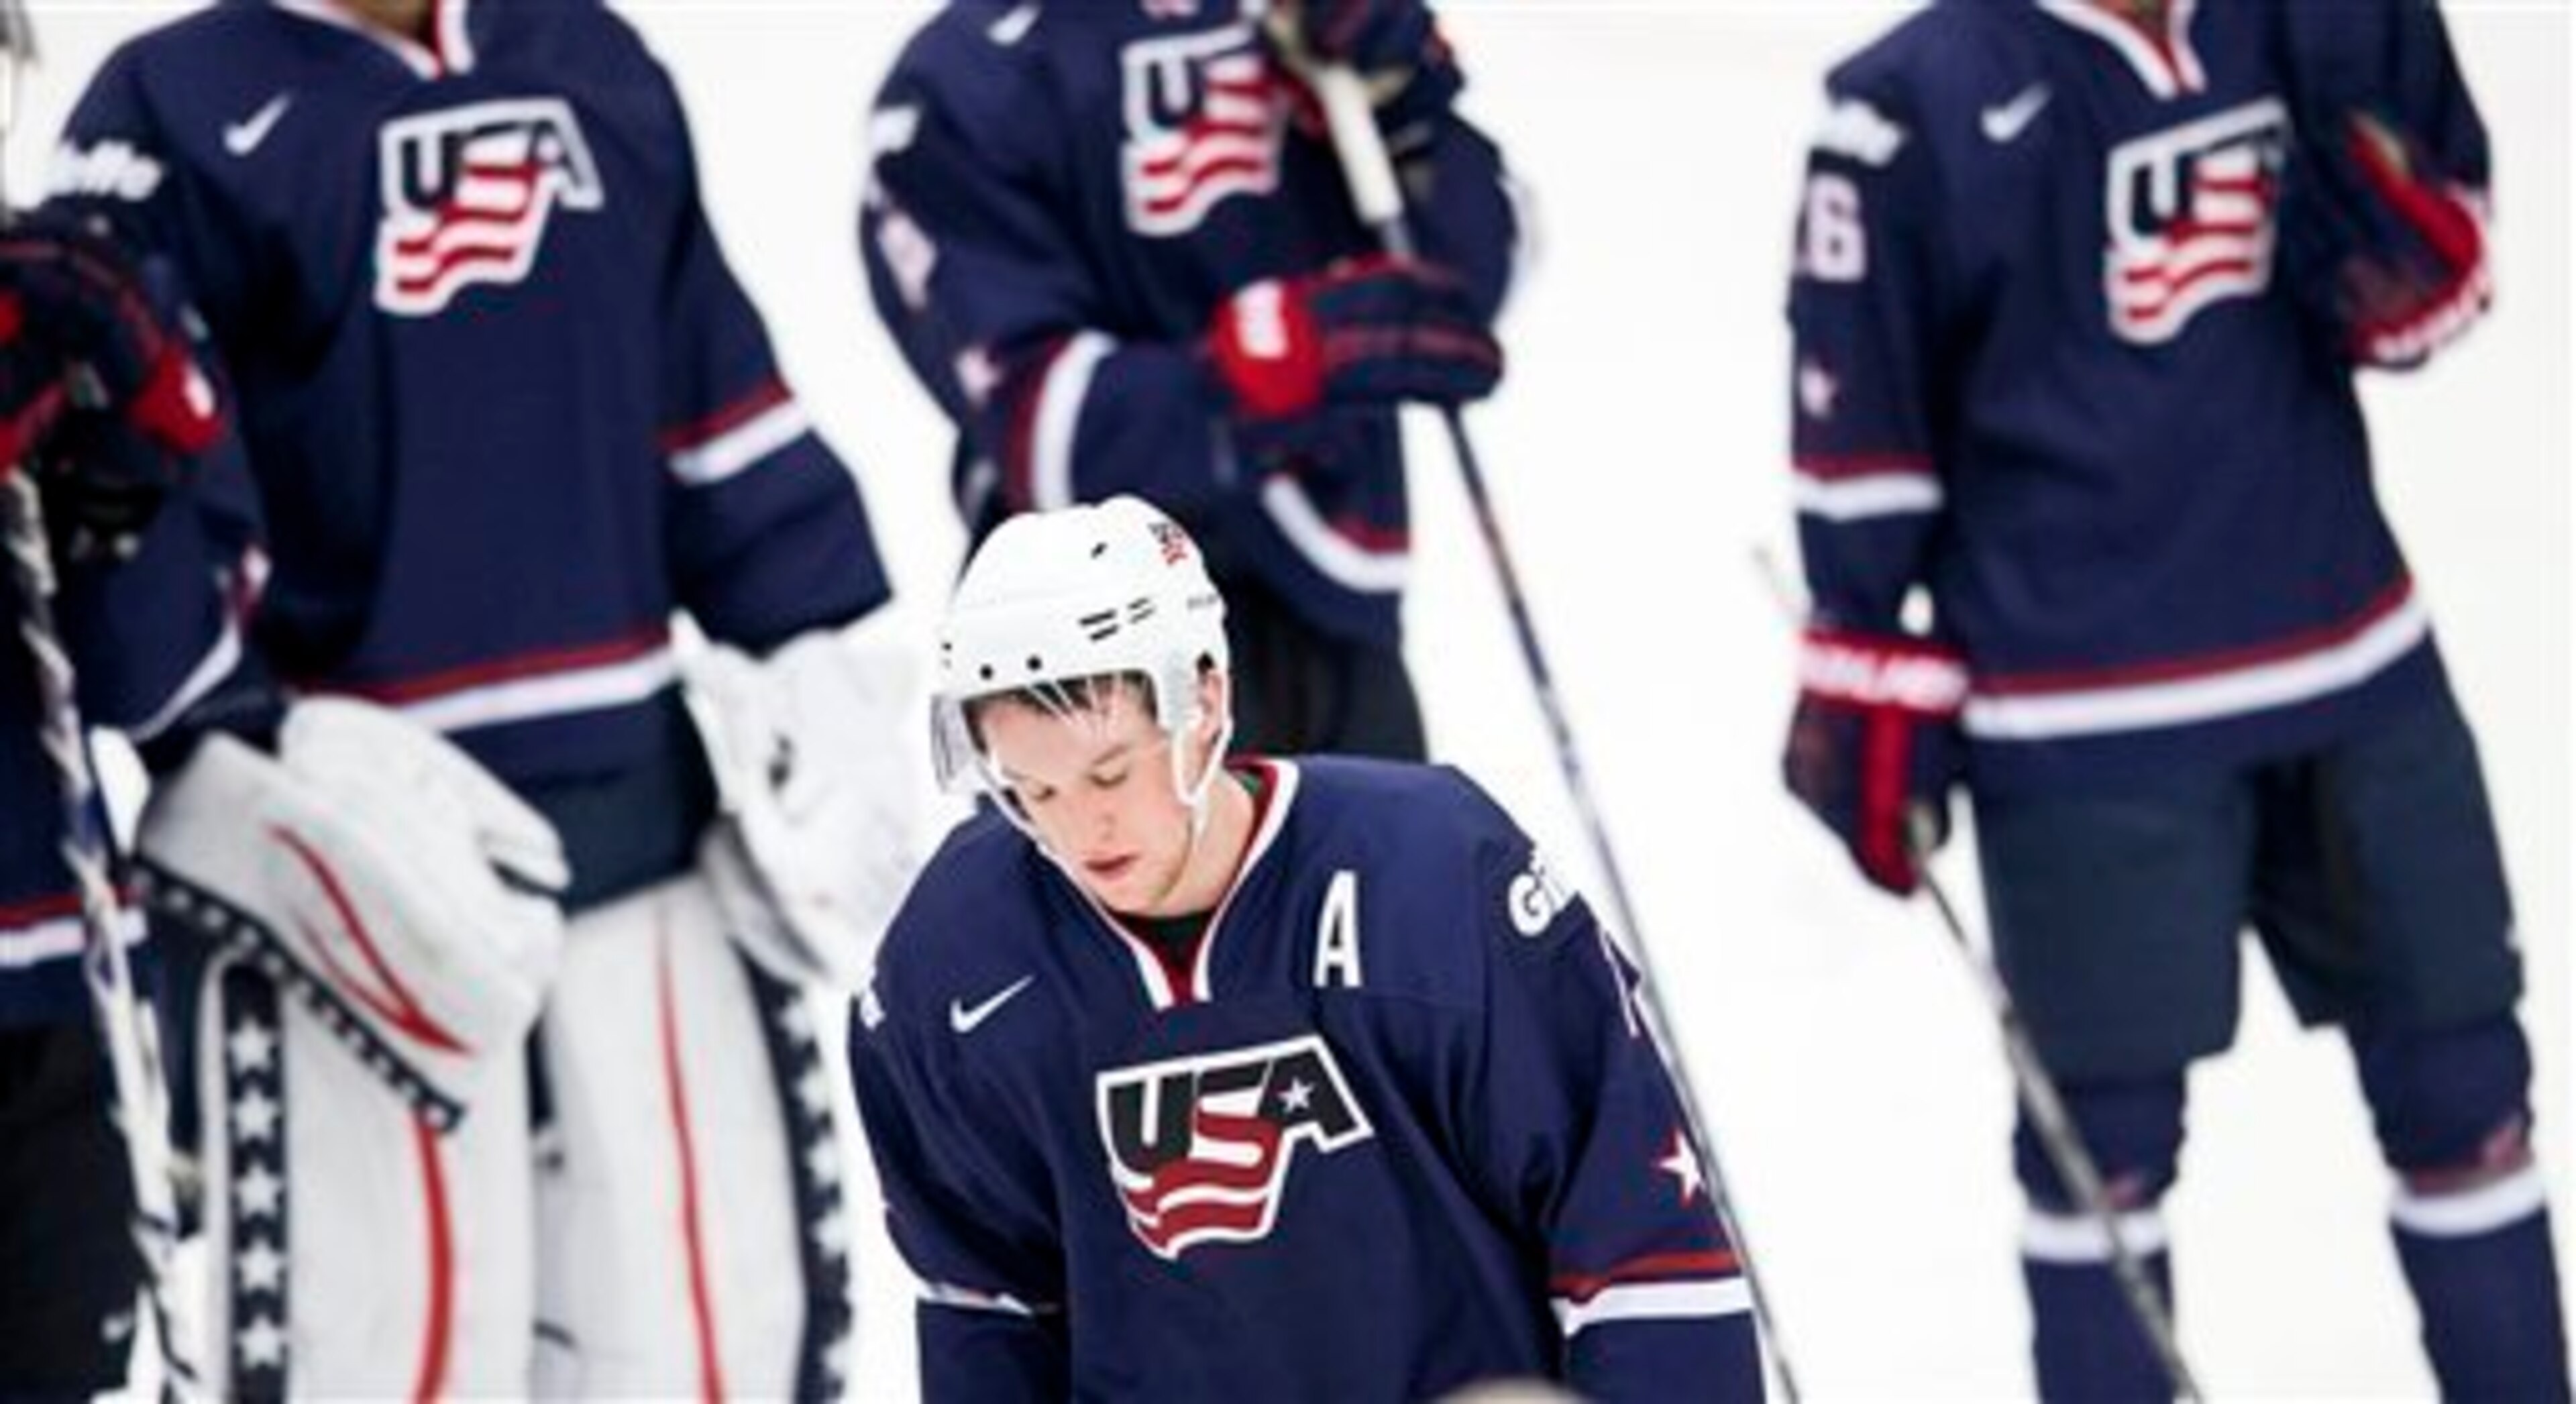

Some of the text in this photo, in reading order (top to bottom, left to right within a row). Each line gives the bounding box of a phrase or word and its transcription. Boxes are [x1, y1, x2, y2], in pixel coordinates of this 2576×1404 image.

[379, 98, 602, 278] USA
[1313, 869, 1362, 987] A
[1096, 1033, 1374, 1231] USA
